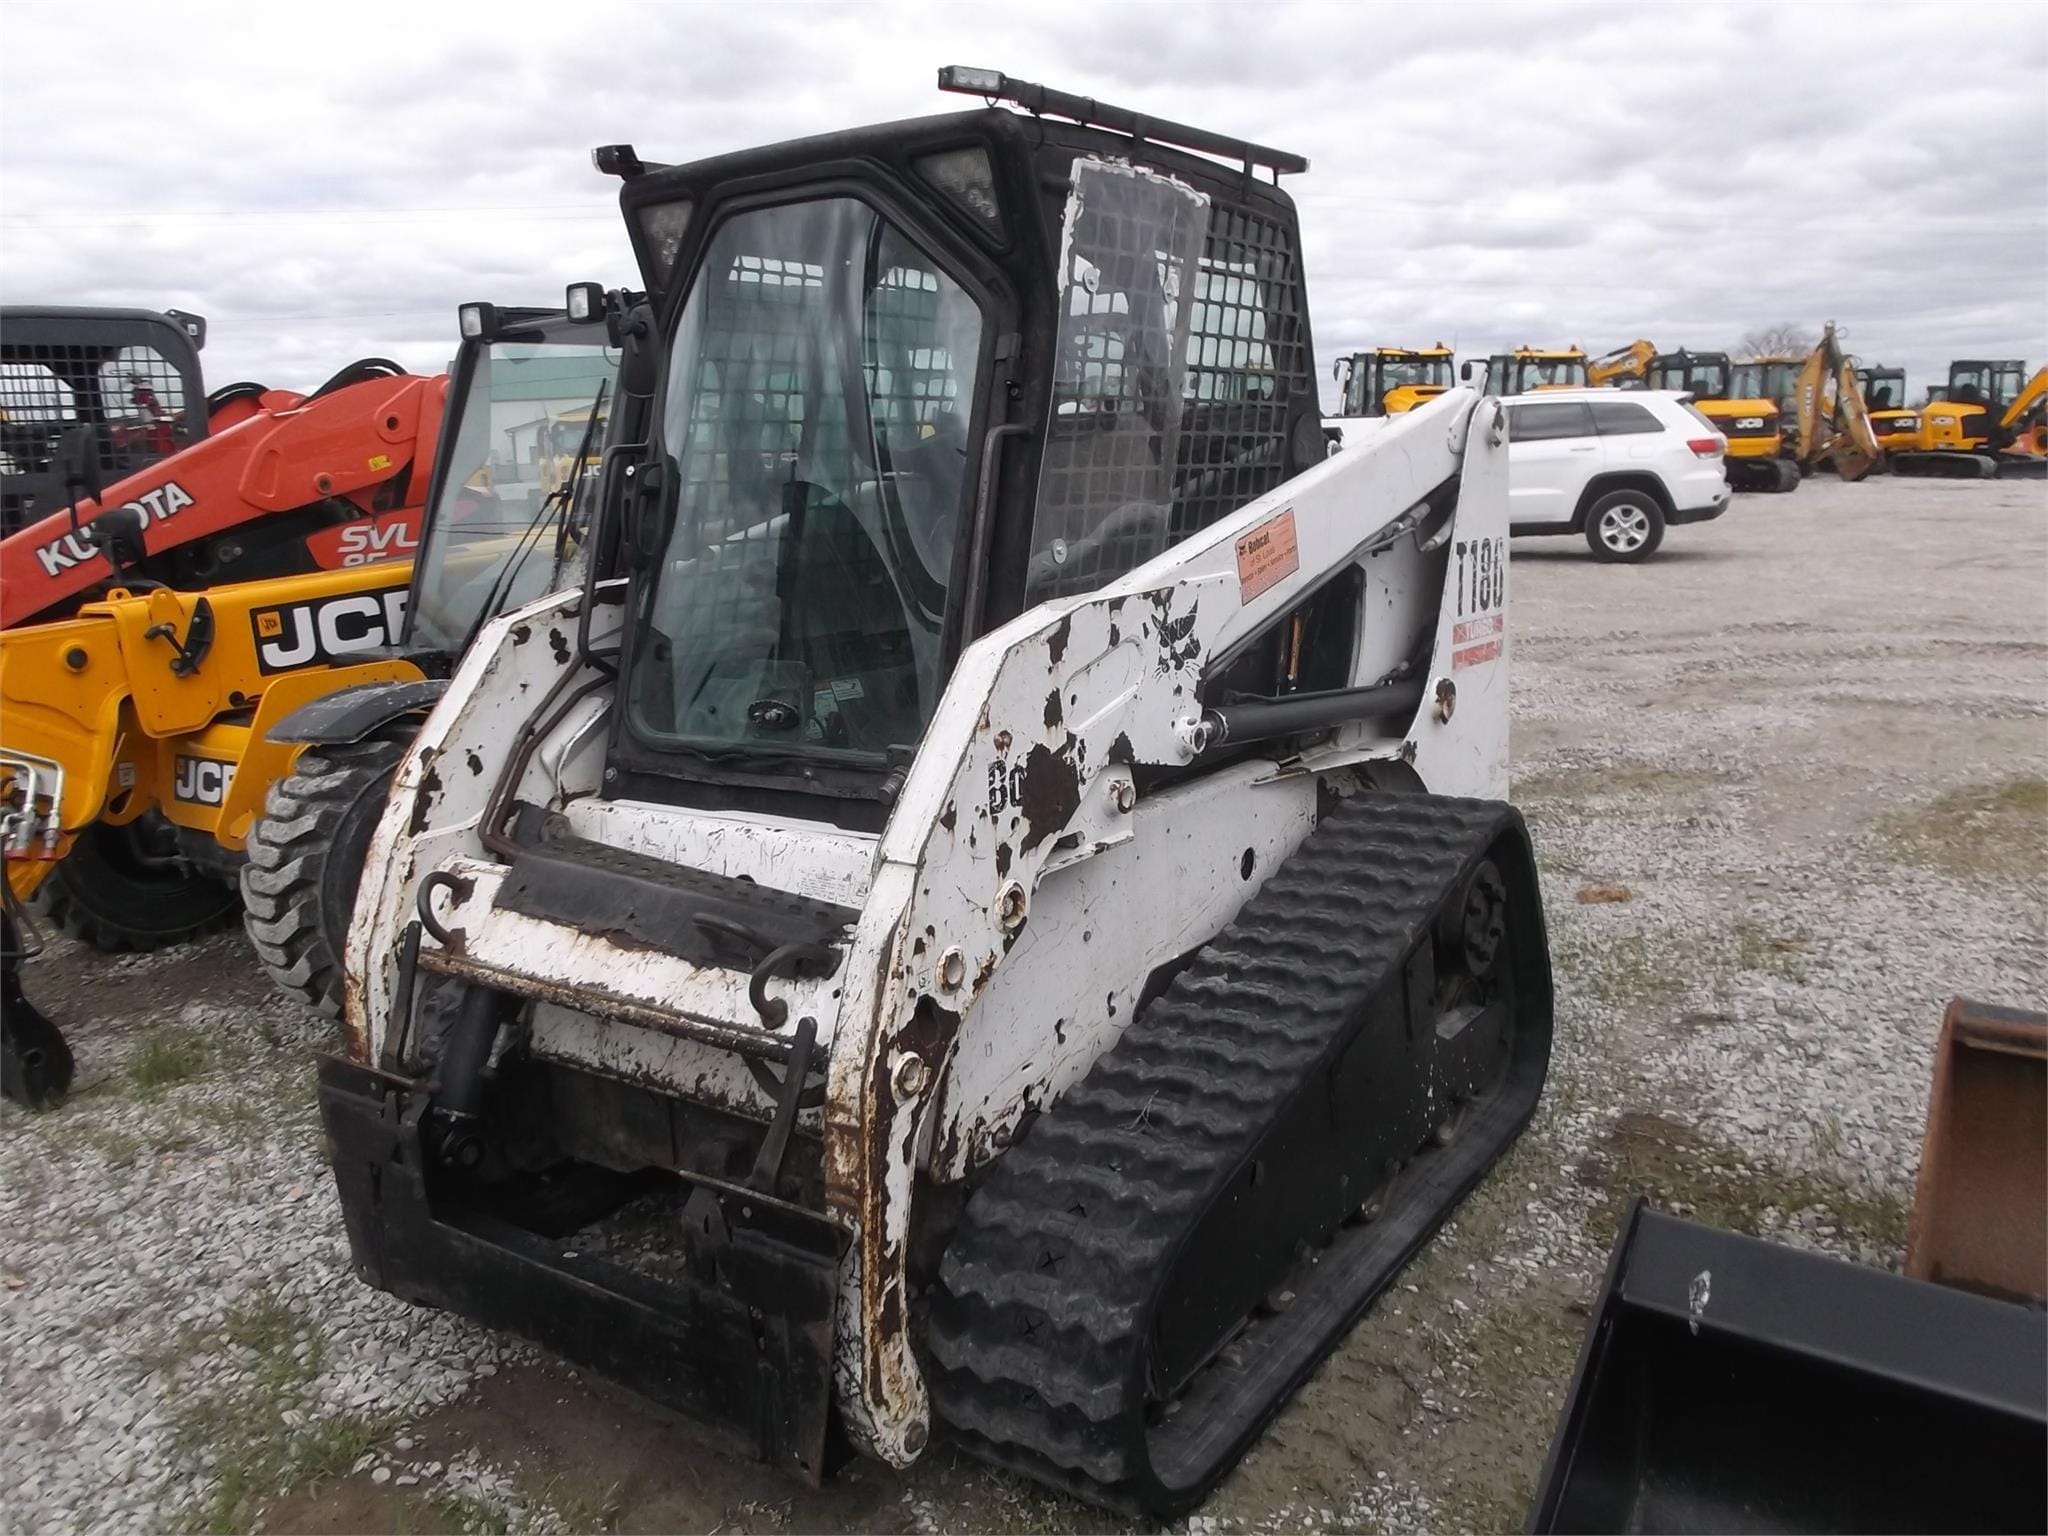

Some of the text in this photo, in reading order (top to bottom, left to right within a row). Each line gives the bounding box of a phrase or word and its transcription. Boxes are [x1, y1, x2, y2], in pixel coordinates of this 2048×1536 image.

[1736, 418, 1764, 429] JCB
[337, 523, 420, 553] SVL
[1248, 530, 1270, 555] Bobcat
